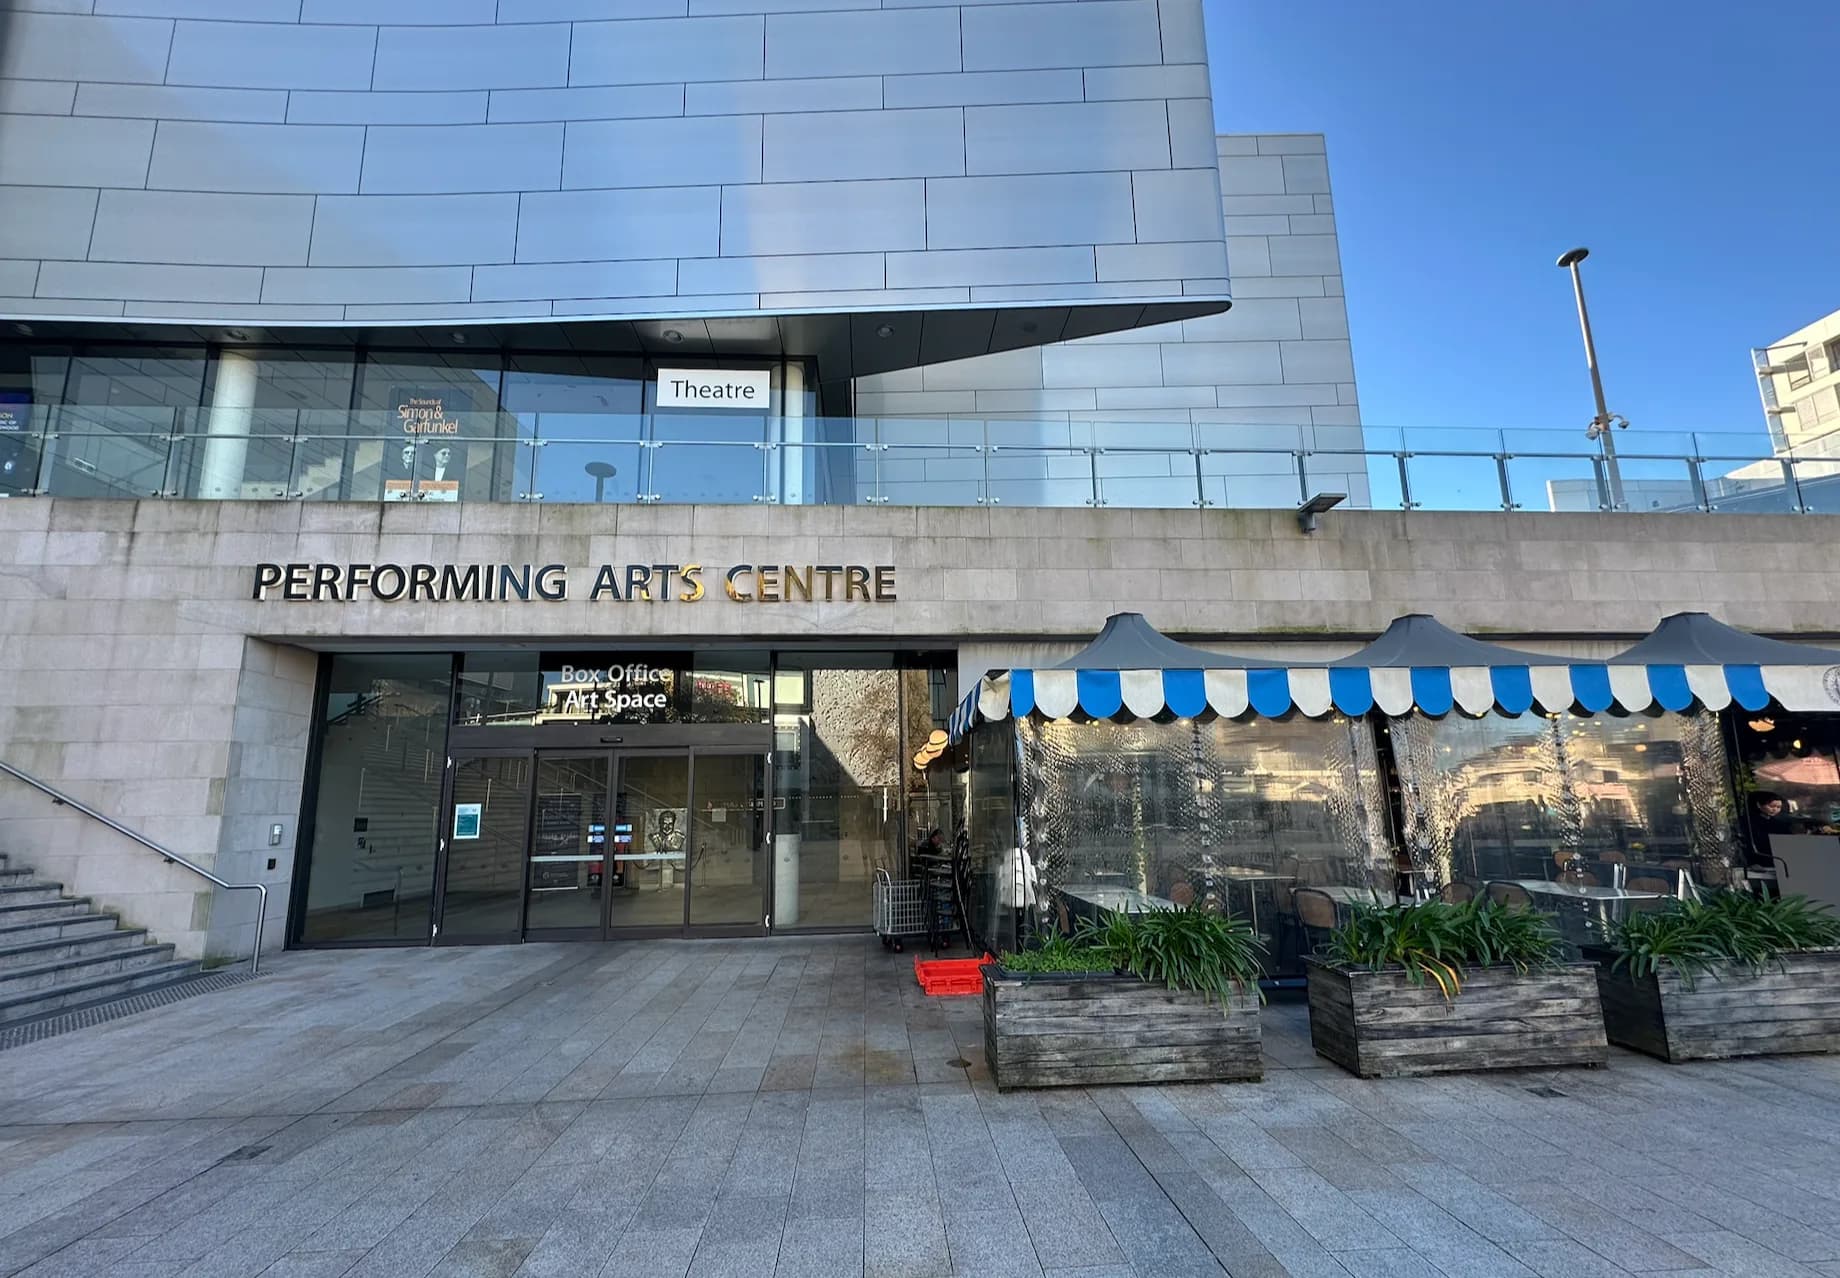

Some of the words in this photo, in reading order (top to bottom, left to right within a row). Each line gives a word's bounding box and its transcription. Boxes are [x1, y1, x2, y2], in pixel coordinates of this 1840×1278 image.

[670, 379, 755, 399] Theatre
[397, 404, 433, 419] Simon
[433, 405, 443, 419] &
[403, 418, 458, 434] Garfunkel
[252, 563, 568, 601] PERFORMING
[589, 564, 705, 602] ARTS
[725, 564, 897, 602] CENTRE
[561, 664, 601, 683] Box
[607, 663, 672, 683] Office
[564, 689, 599, 710] Art
[604, 689, 667, 713] Space
